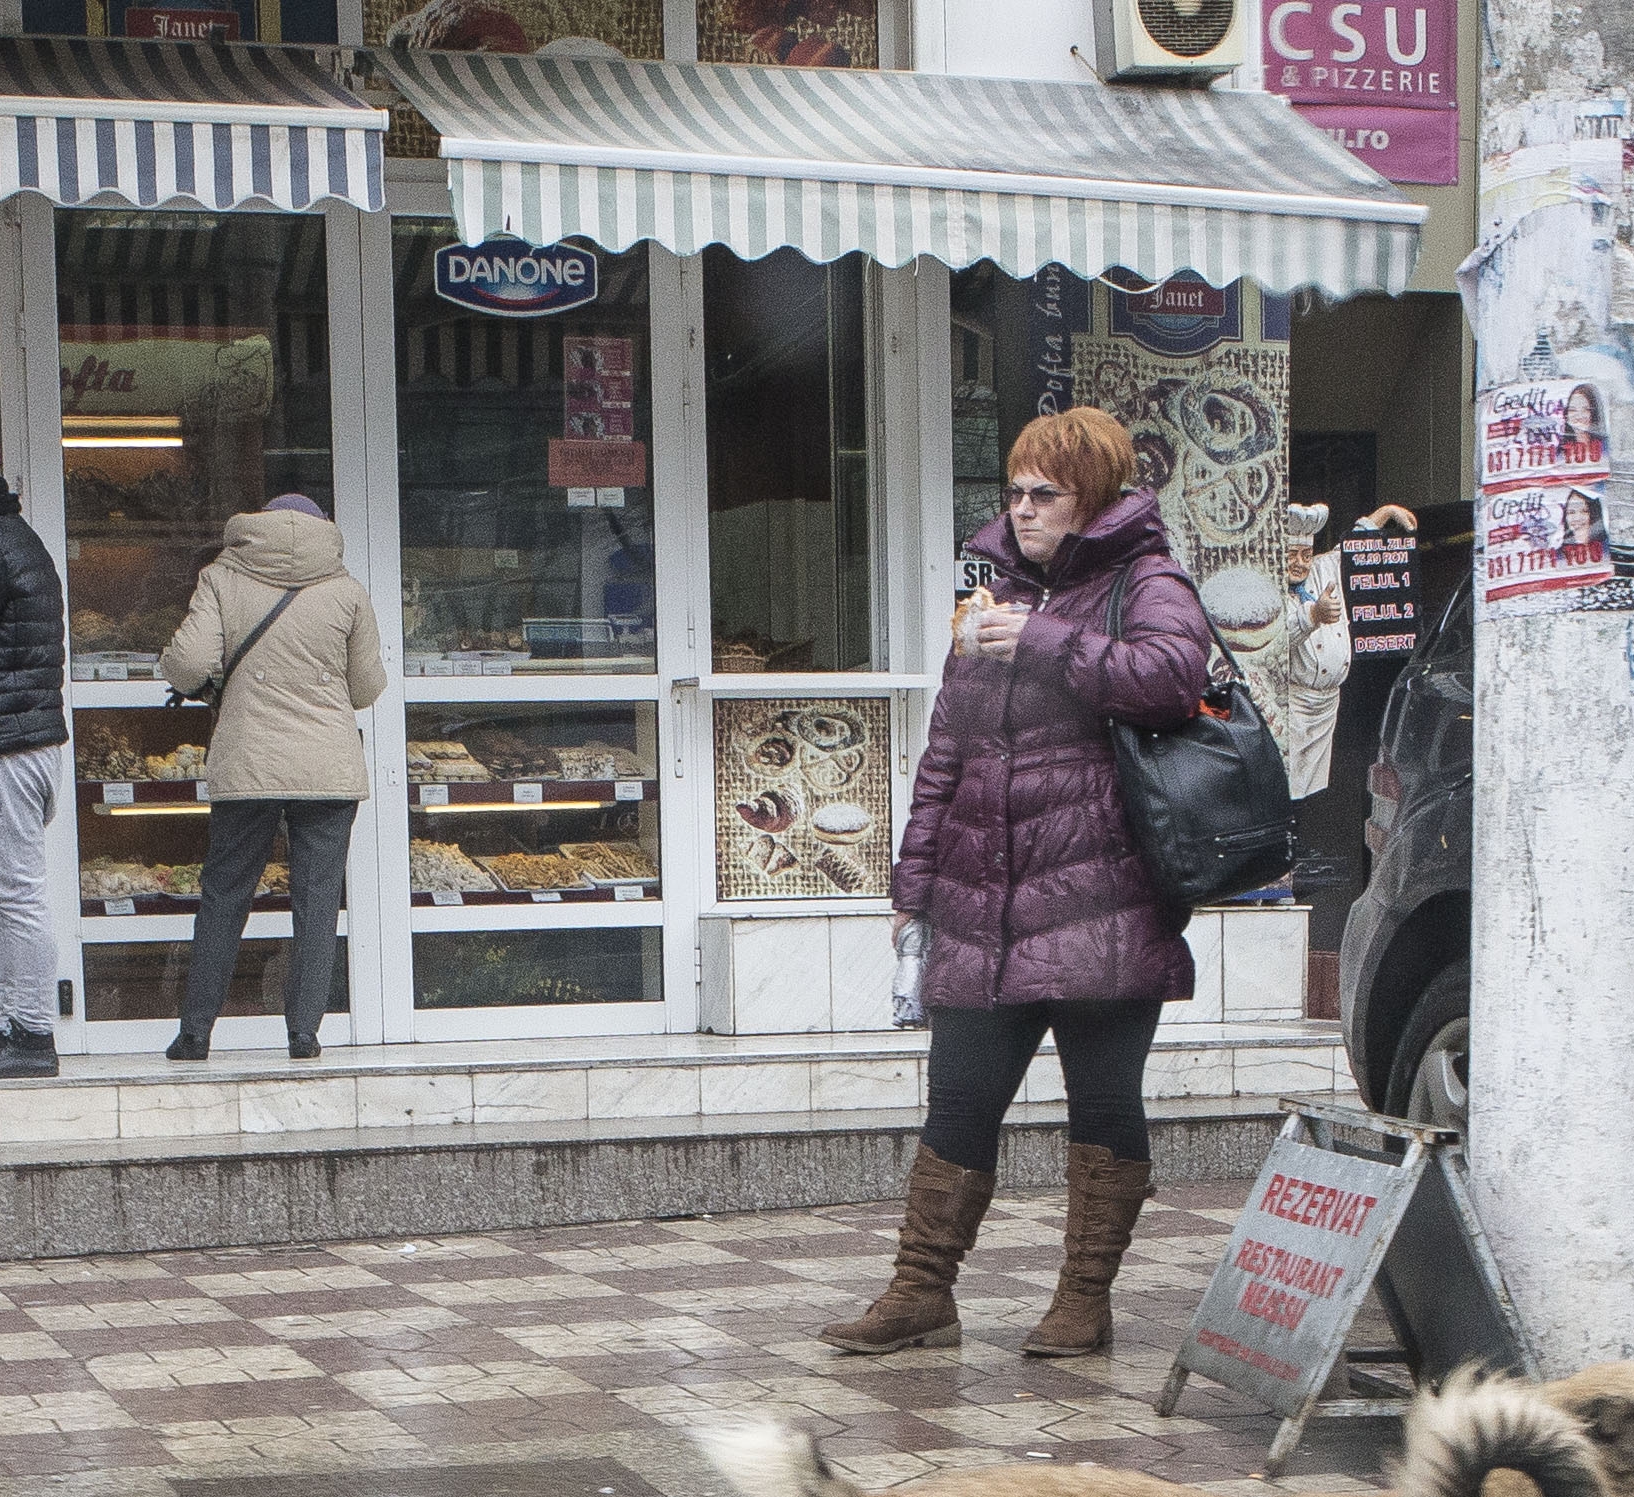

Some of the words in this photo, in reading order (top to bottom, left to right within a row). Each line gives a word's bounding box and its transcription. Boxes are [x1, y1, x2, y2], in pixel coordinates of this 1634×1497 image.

[1268, 2, 1427, 67] CSU
[1281, 65, 1302, 88] &
[1310, 67, 1441, 94] PIZZERIE
[1149, 289, 1205, 310] Janet
[1349, 571, 1400, 591] FELUL
[1401, 571, 1412, 587] 1
[1352, 603, 1402, 622] FELUL
[1403, 602, 1415, 619] 2
[1354, 632, 1417, 654] DESERT
[1260, 1174, 1378, 1237] REZERVAT
[1233, 1238, 1345, 1299] RESTAURANT
